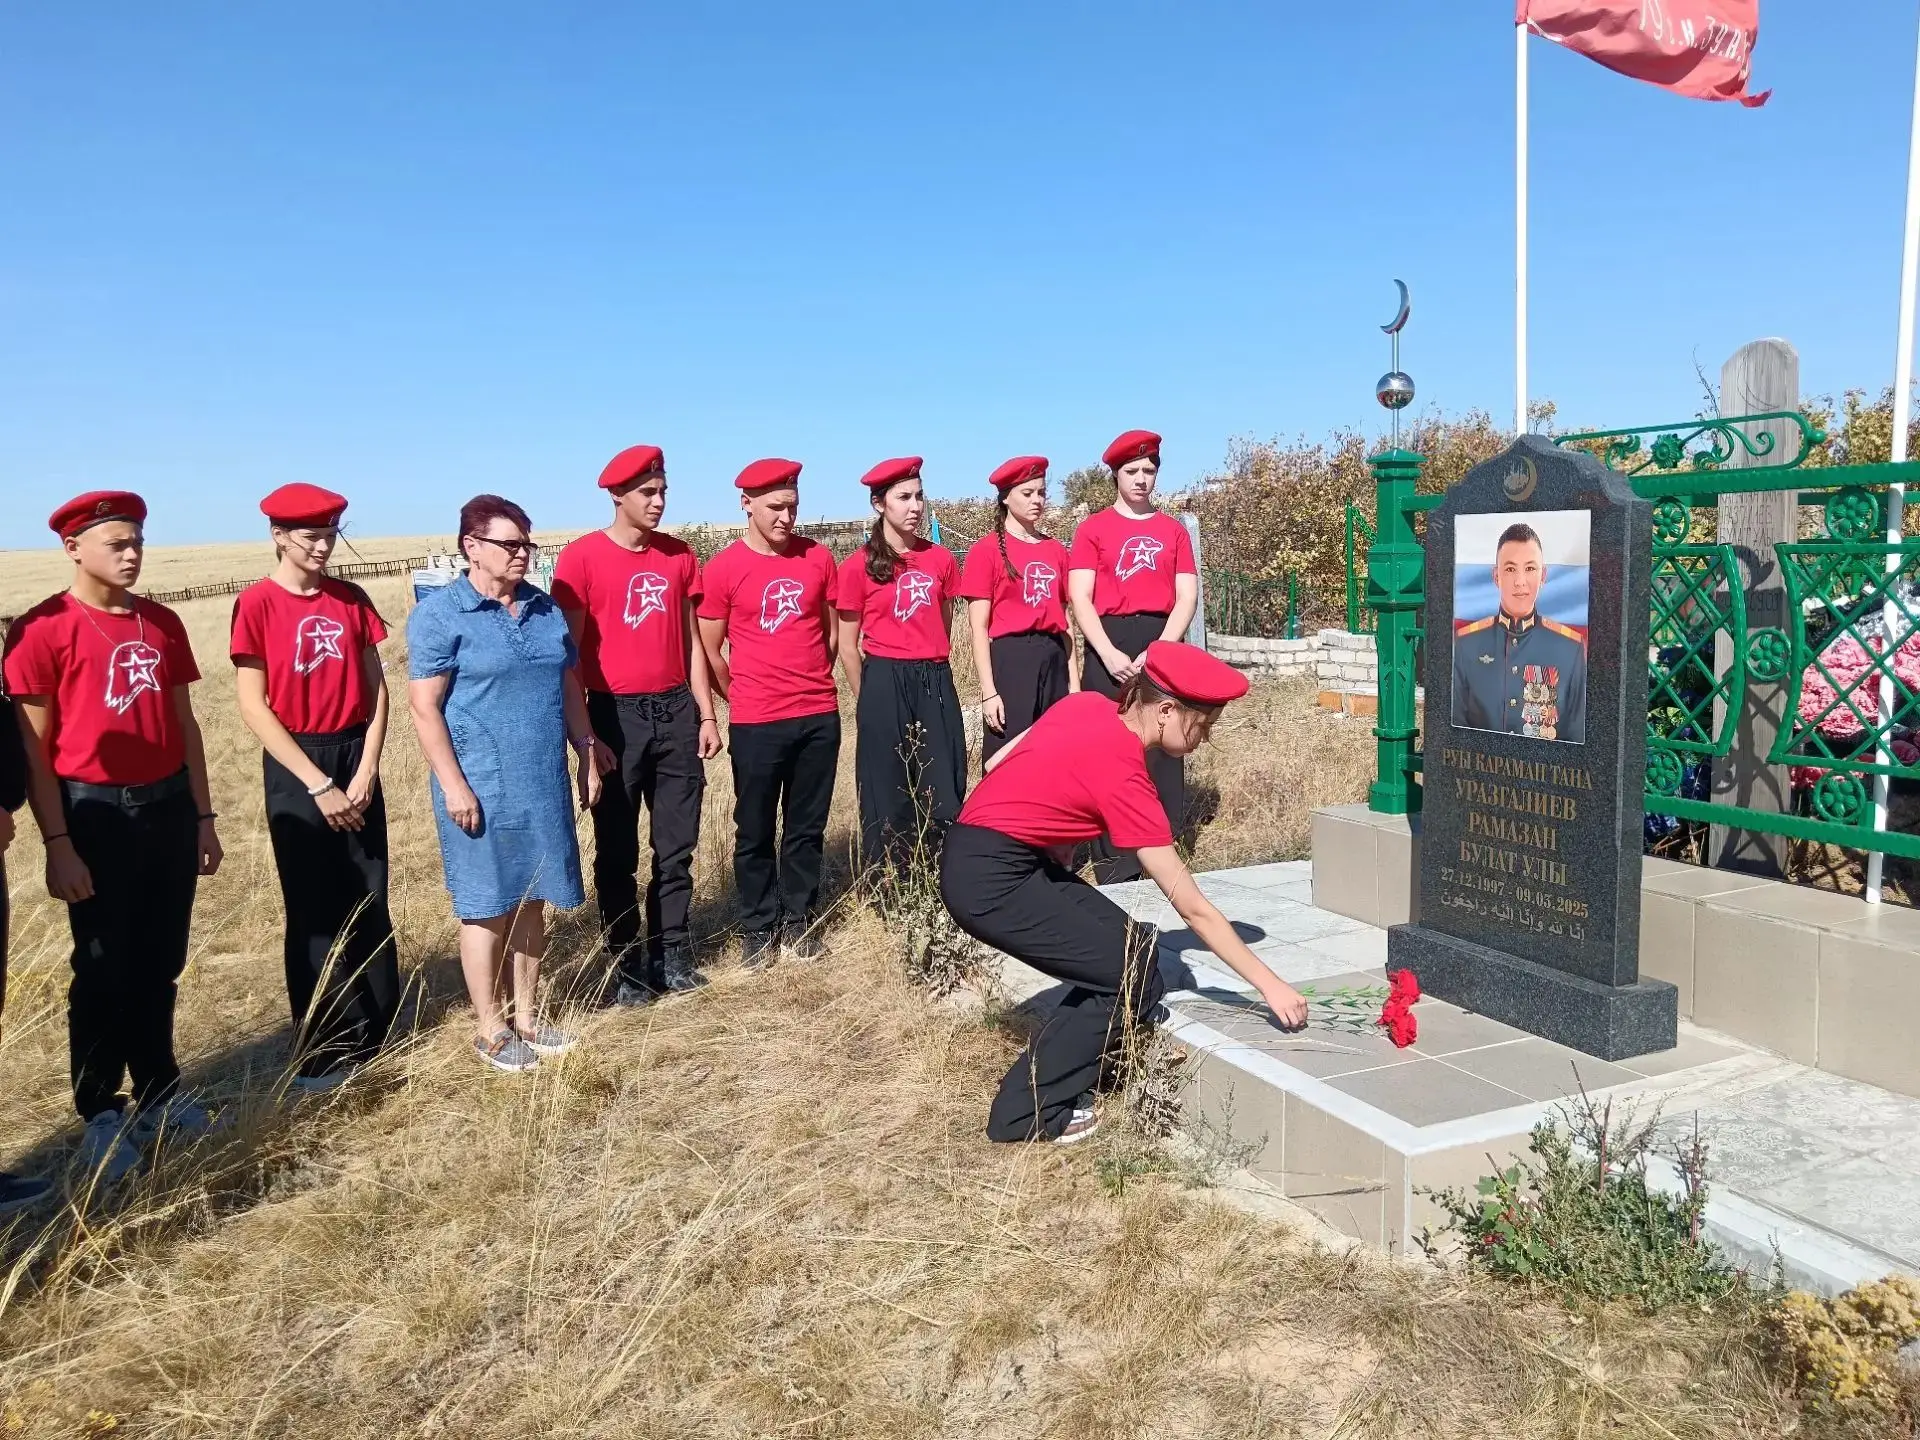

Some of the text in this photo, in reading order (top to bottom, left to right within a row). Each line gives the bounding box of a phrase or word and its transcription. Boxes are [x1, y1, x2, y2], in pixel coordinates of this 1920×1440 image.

[1442, 748, 1593, 791] РУЫ КАРАМАН ТАНА
[1455, 778, 1577, 821] УРАЗГАЛИЕВ
[1469, 811, 1557, 850] РАМАЗАН
[1460, 840, 1568, 887] БУЛАТ УЛЫ
[1440, 867, 1505, 896] 27.12.1997
[1515, 886, 1589, 919] 09.03.2025
